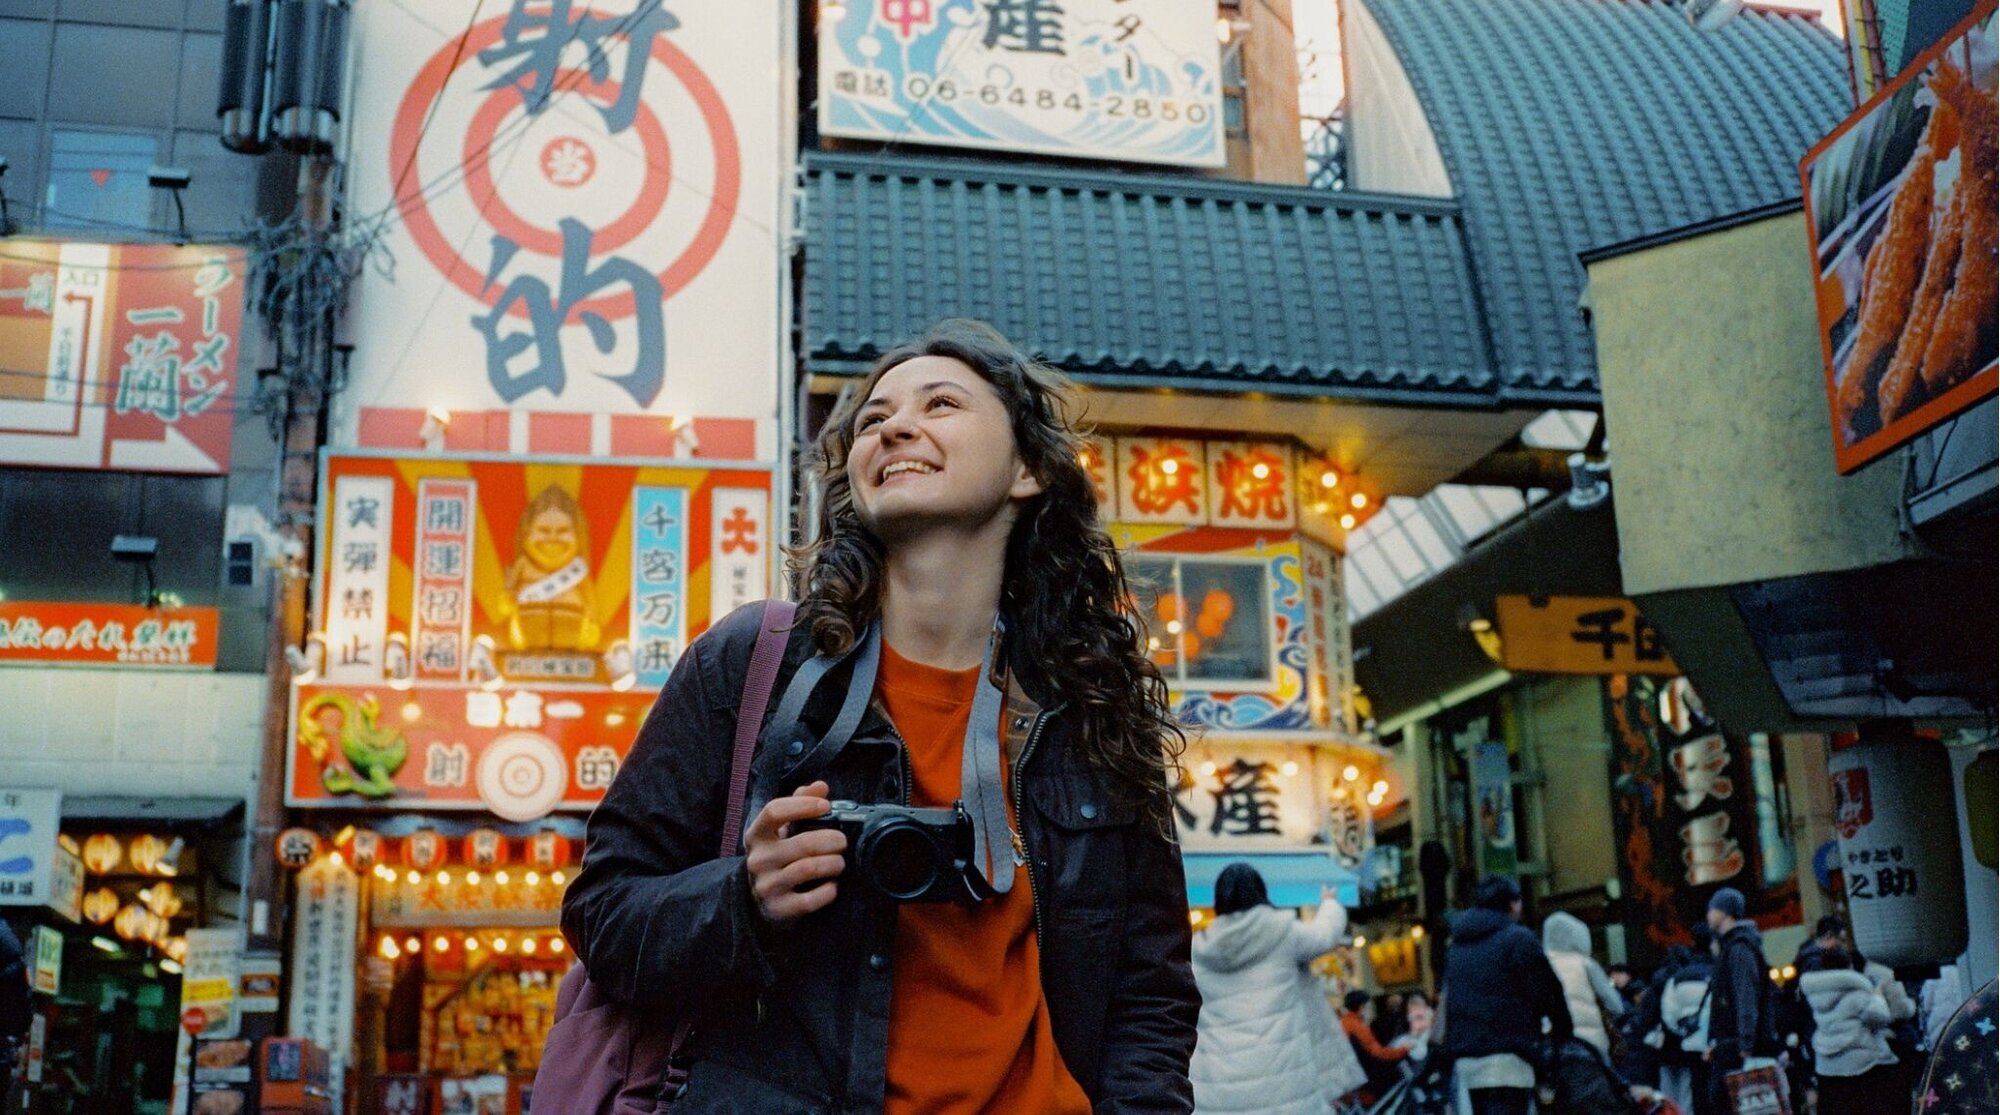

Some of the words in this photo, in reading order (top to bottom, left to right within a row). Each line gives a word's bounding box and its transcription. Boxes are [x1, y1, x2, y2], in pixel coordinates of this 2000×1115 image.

[833, 69, 889, 98] 電話
[907, 76, 1207, 124] 06-6484-2850
[472, 0, 682, 409] 射的
[64, 270, 100, 287] 入口
[114, 304, 185, 422] 一蘭
[183, 256, 235, 416] ラーメン
[419, 498, 464, 672] 開運招福
[466, 691, 584, 728] 日本一
[424, 740, 469, 788] 射
[1847, 846, 1905, 865] やきとり
